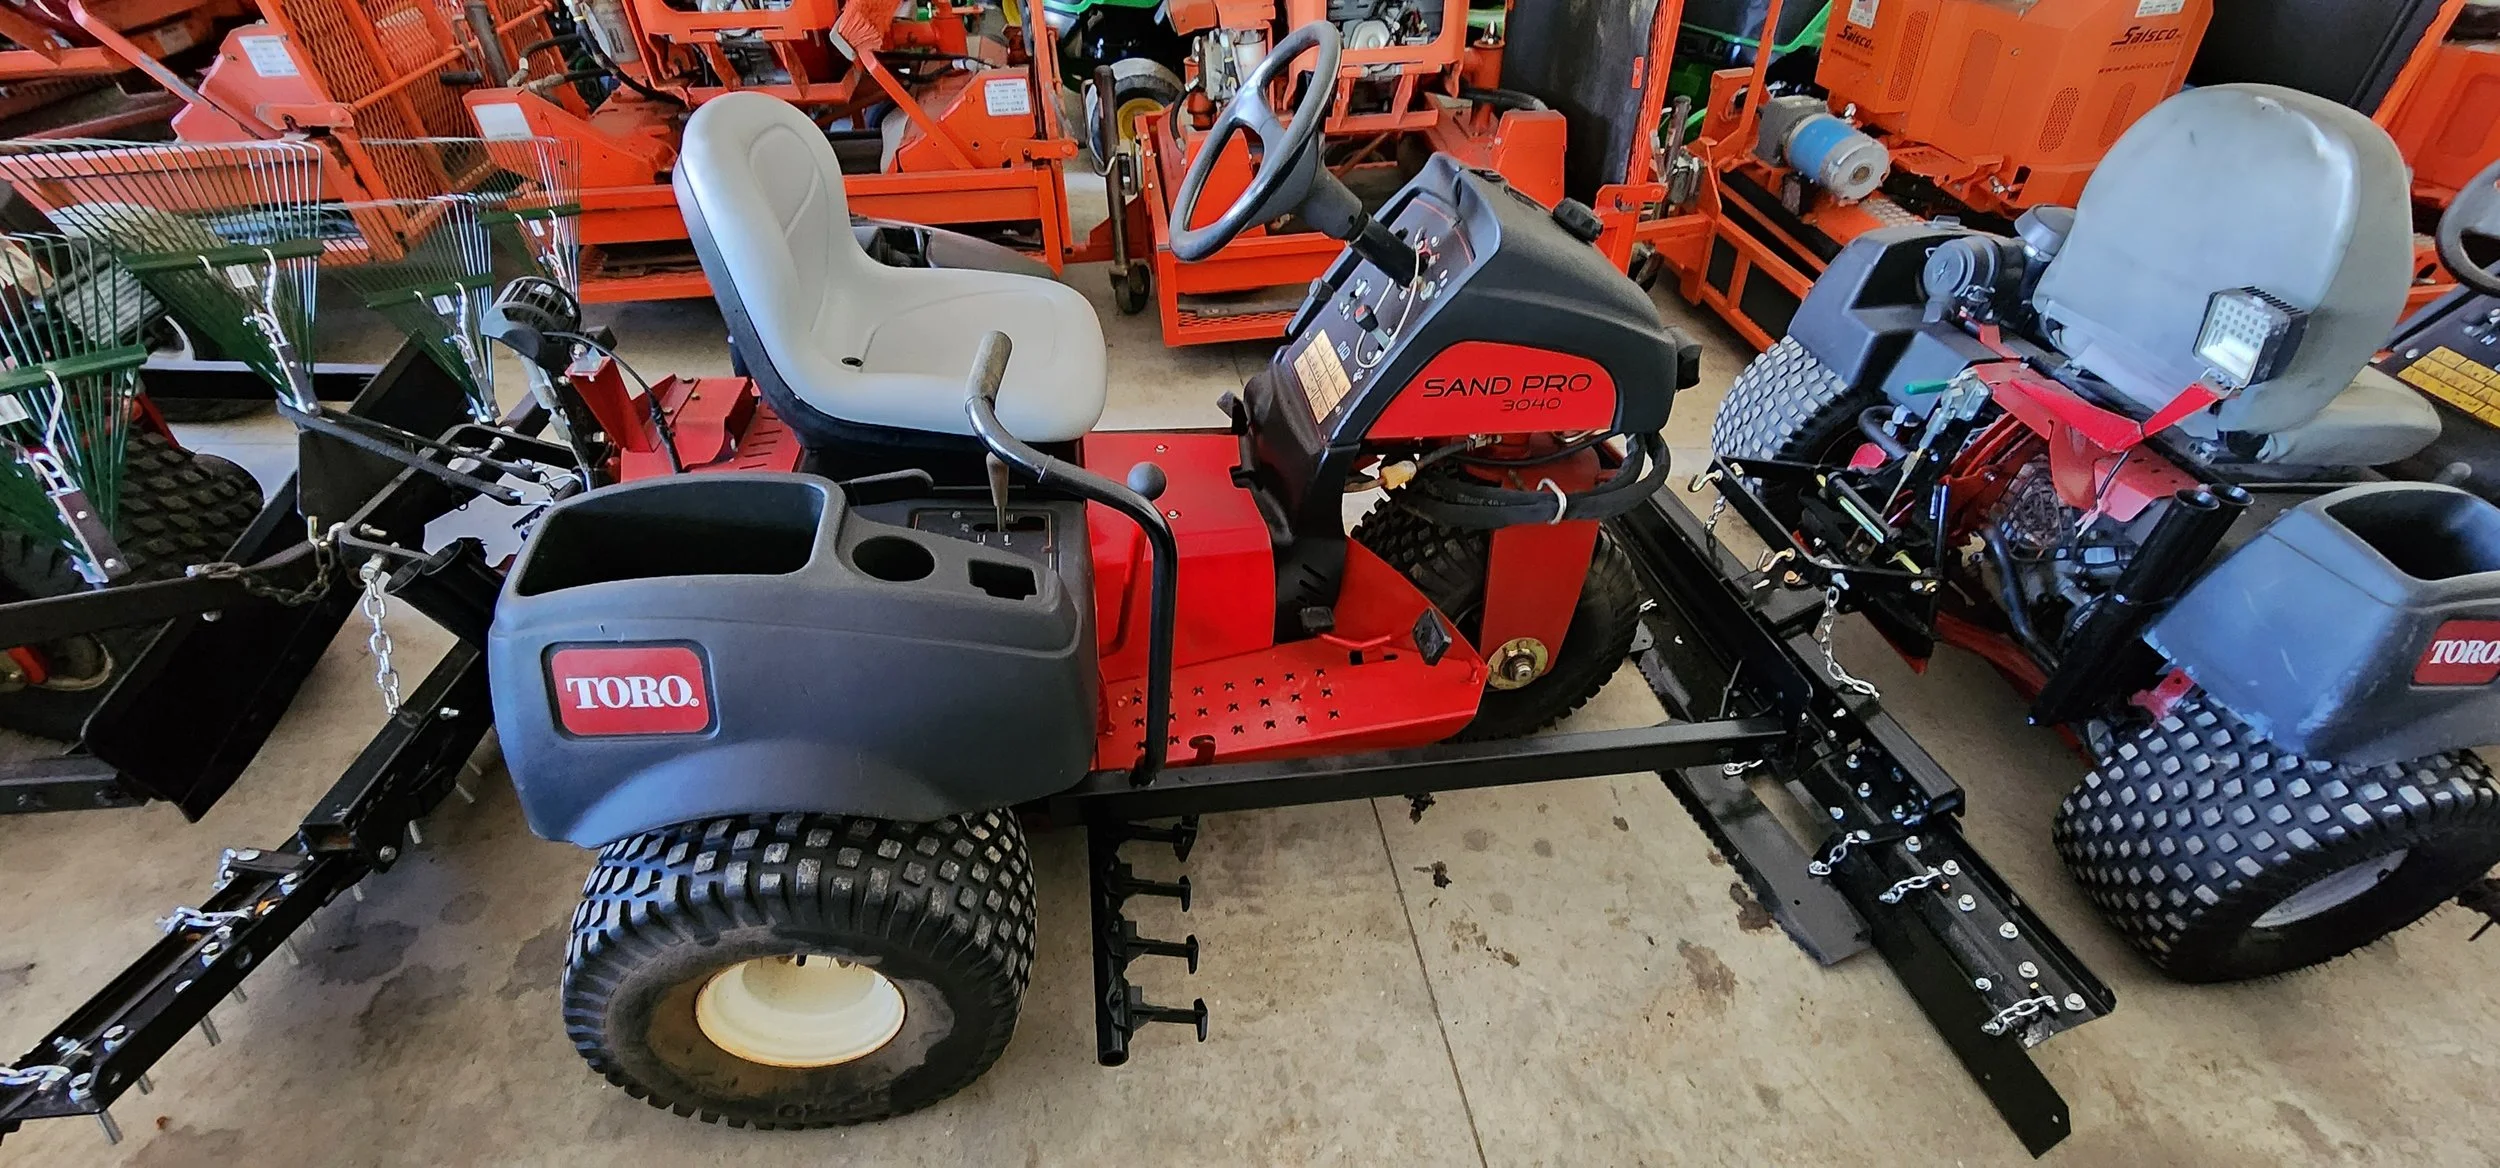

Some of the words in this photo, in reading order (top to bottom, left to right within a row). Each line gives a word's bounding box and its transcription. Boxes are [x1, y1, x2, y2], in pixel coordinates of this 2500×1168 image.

[1836, 24, 1872, 49] Salsco
[2109, 25, 2179, 46] Salsco
[1422, 376, 1512, 398] SAND
[1521, 373, 1592, 394] PRO
[1500, 397, 1562, 412] 3040
[565, 675, 699, 709] TORO
